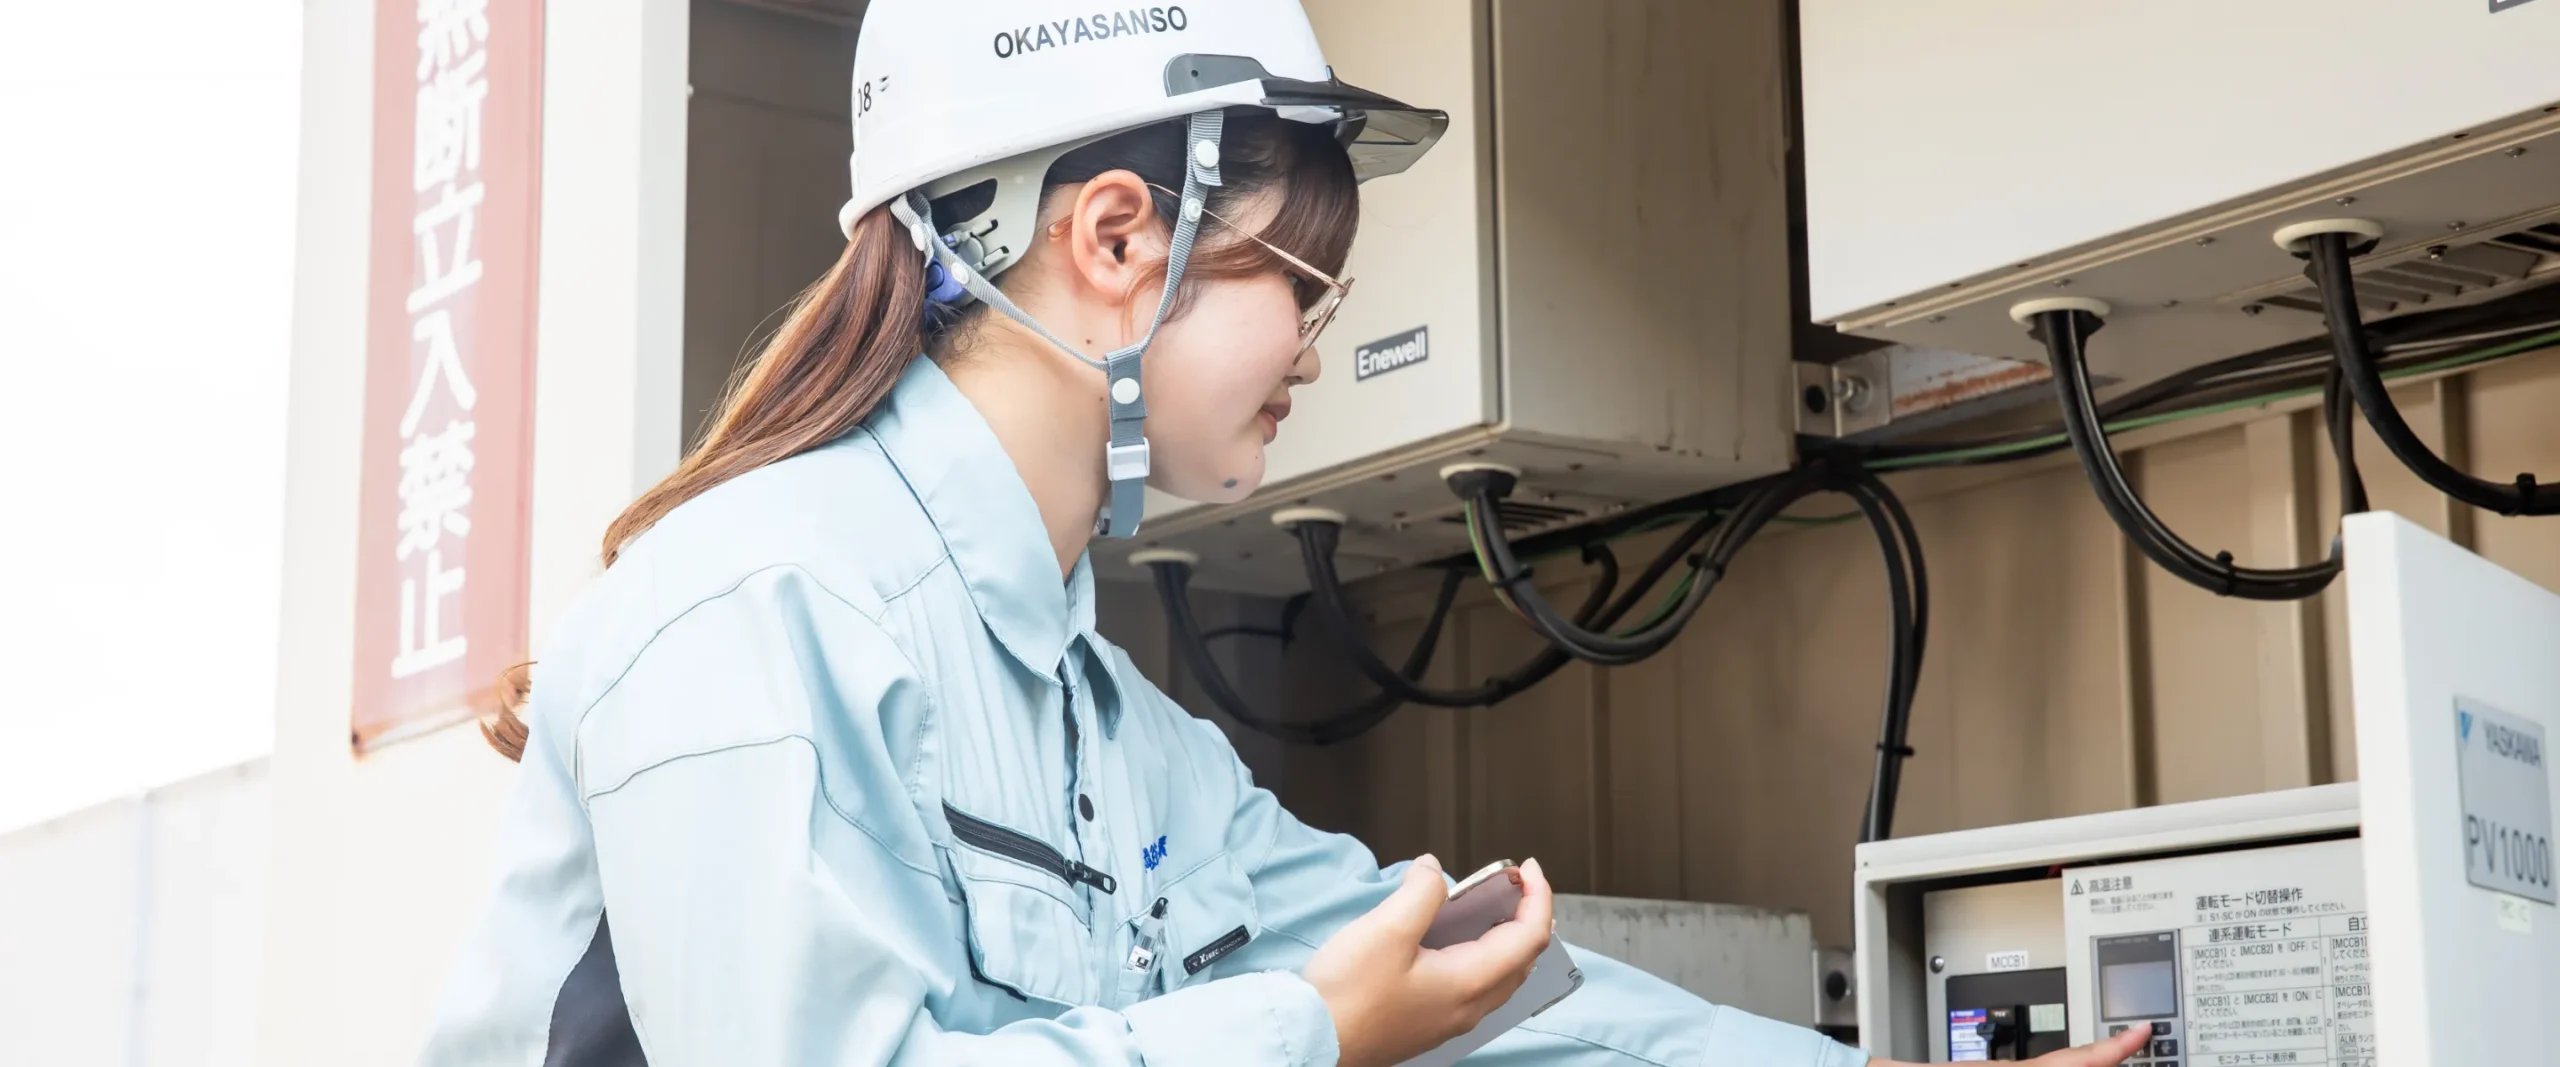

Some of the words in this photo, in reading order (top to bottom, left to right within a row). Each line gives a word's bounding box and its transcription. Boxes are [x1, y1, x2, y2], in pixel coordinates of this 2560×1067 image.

[994, 6, 1188, 58] OKAYASANSO
[391, 0, 489, 679] 無断立入禁止
[1358, 331, 1426, 377] Enewell
[2482, 719, 2542, 770] YASKAWA
[2467, 814, 2550, 888] PV1000
[2195, 888, 2304, 911] 運転モード切替操作
[1991, 955, 2026, 968] MCCB1
